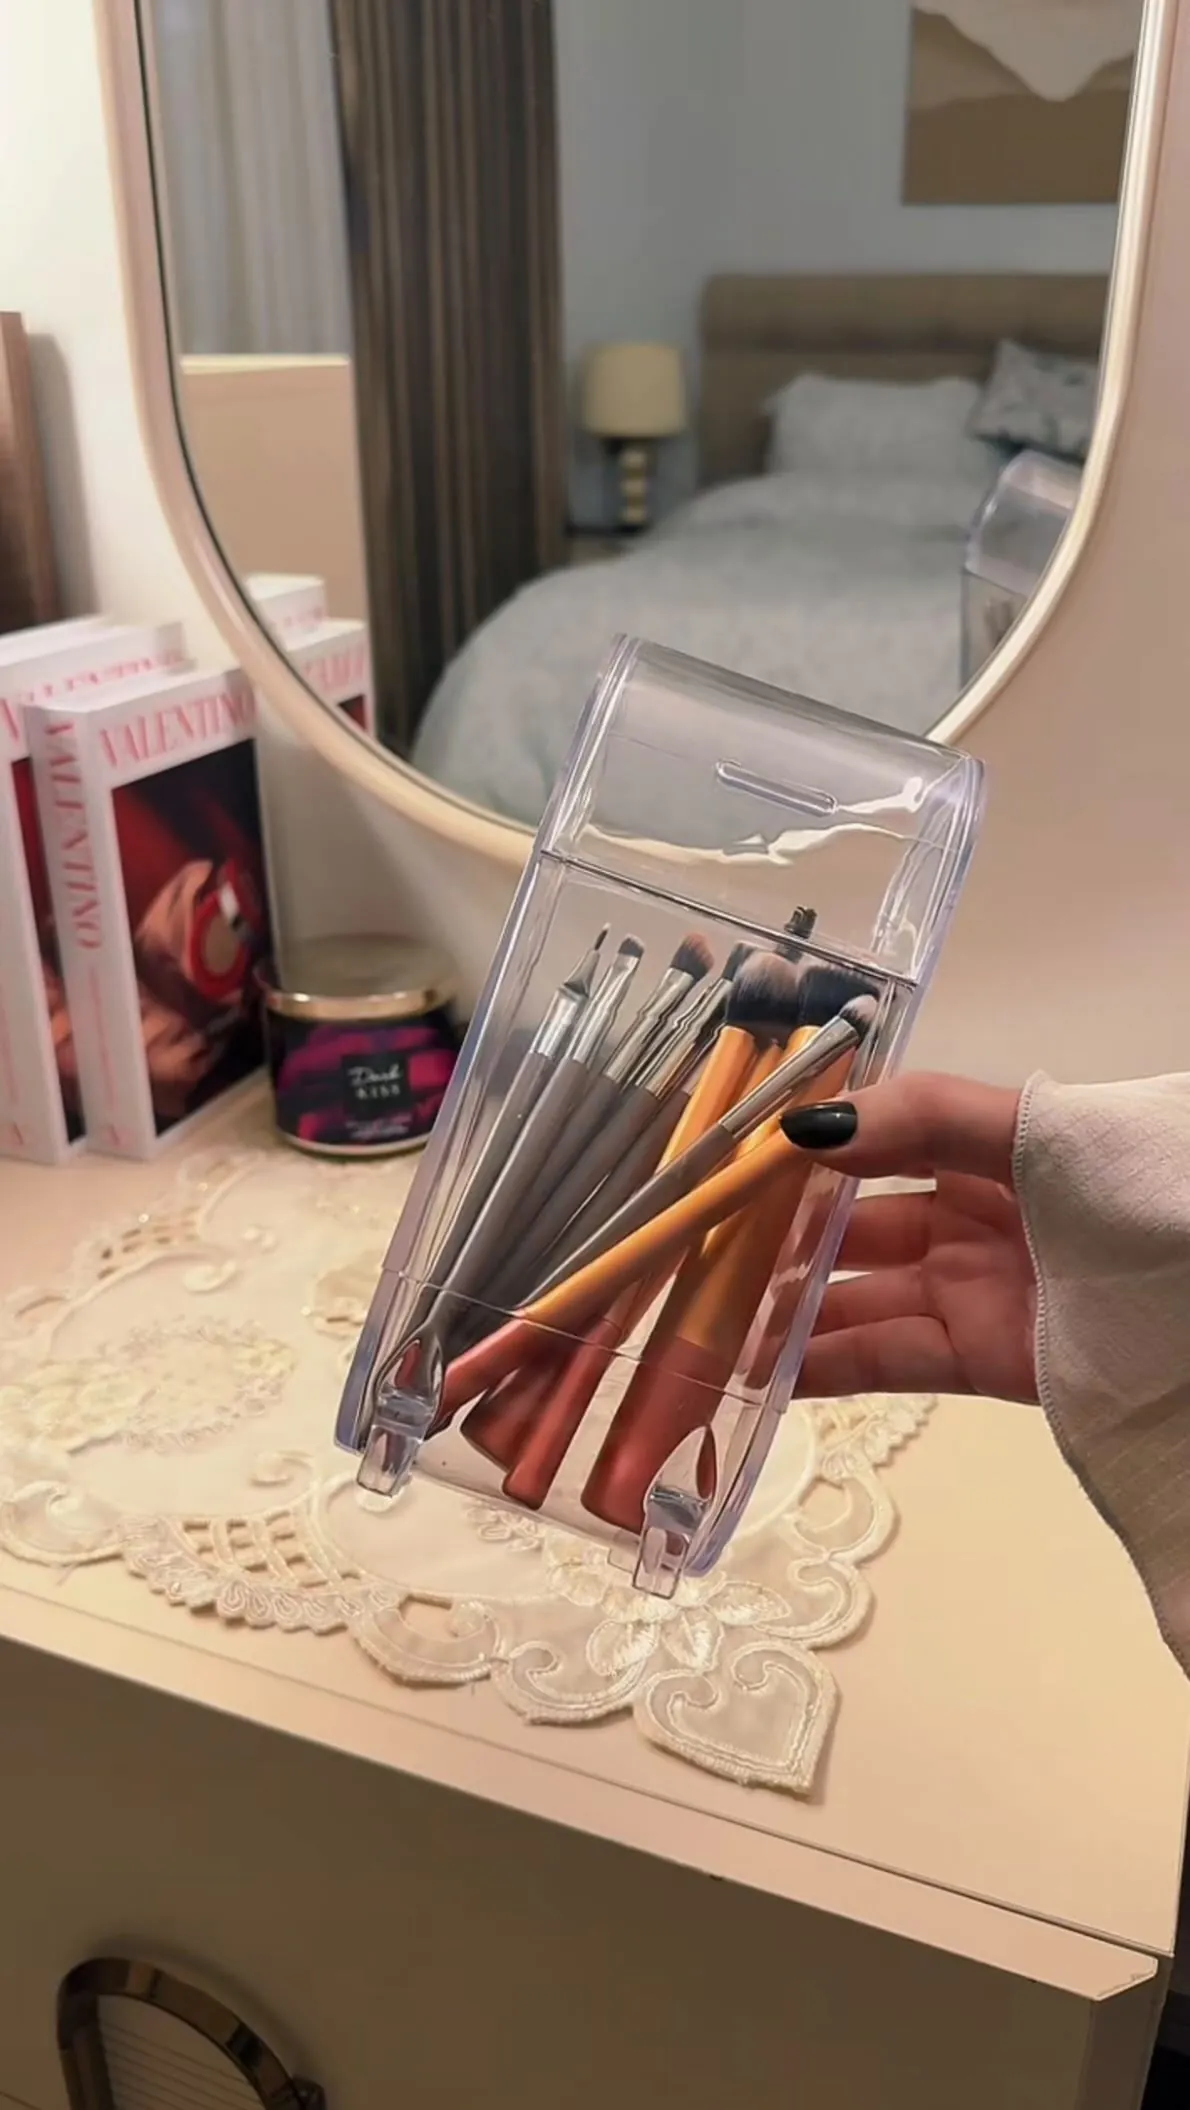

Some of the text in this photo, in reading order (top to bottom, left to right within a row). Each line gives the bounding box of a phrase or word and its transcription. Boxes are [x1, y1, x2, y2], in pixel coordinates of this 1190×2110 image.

[100, 690, 257, 769] VALENTINO
[46, 723, 103, 950] VALENTINO
[347, 1063, 401, 1087] Dark
